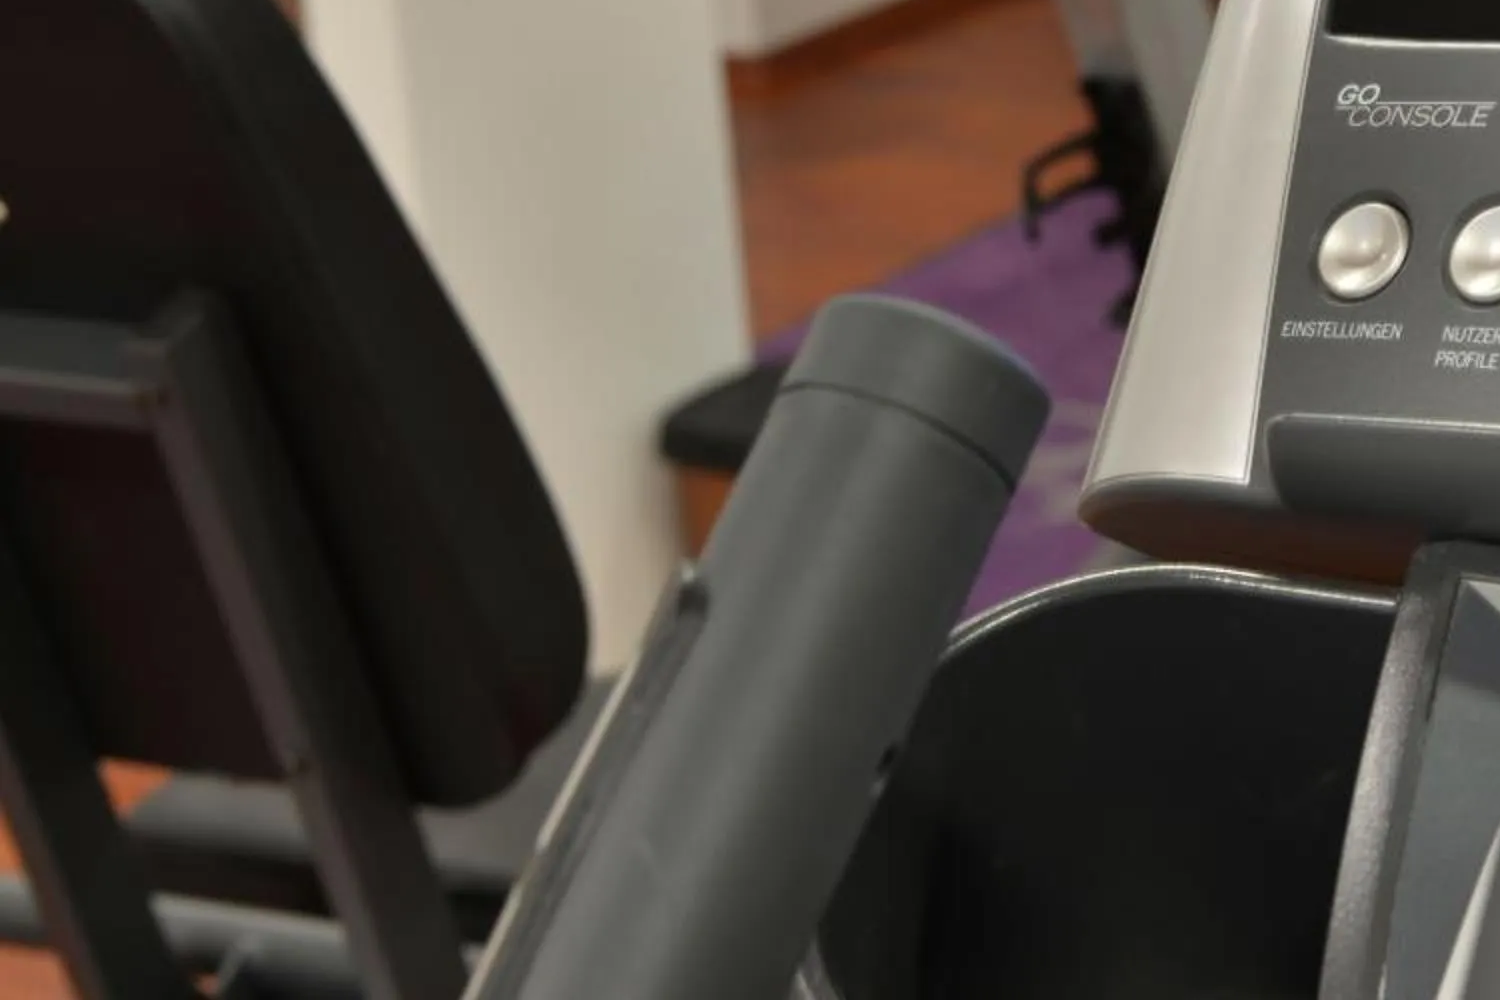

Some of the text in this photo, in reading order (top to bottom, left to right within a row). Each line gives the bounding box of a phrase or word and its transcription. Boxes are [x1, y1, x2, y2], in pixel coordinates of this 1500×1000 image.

[1337, 83, 1381, 105] GO
[1348, 104, 1494, 127] CONSOLE
[1280, 320, 1403, 340] EINSTELLUNGEN
[1434, 351, 1500, 370] PROFILE
